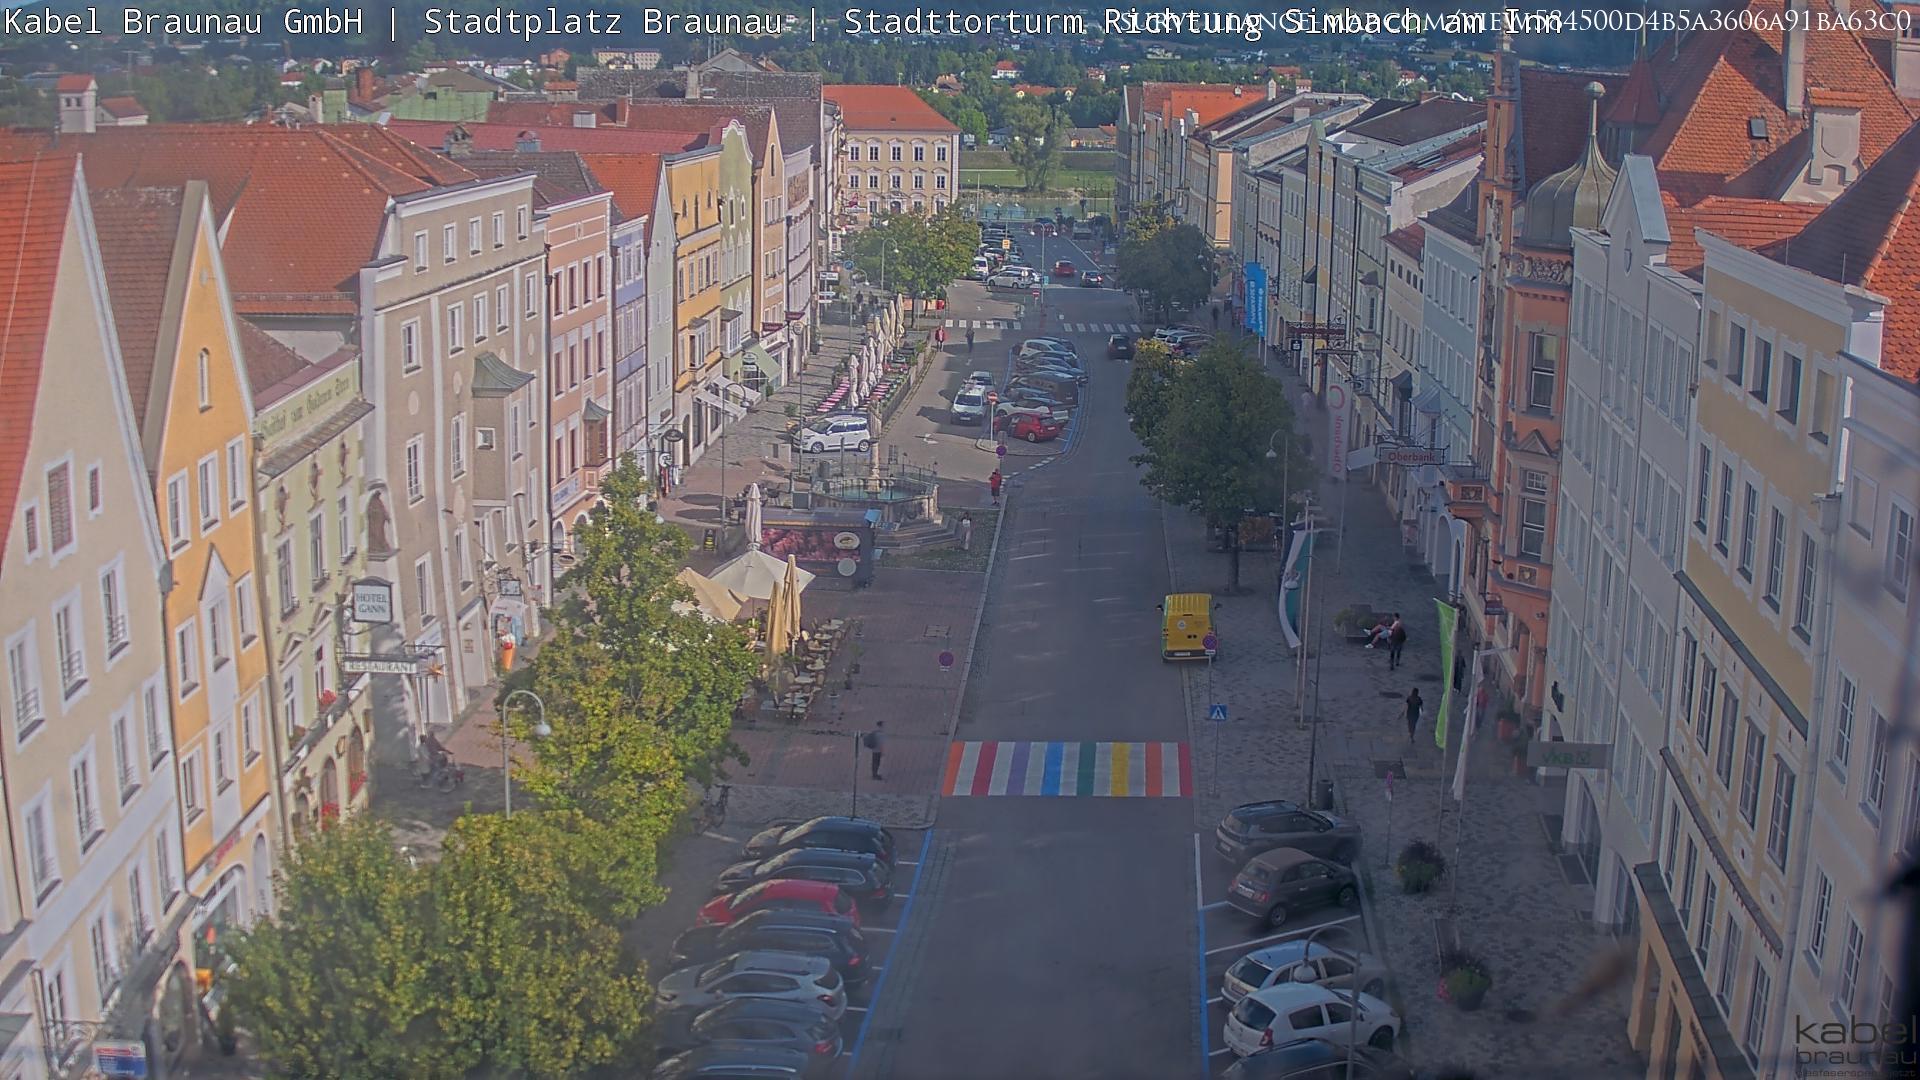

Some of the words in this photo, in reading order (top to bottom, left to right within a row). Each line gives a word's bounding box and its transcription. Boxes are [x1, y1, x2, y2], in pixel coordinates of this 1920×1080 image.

[1388, 451, 1436, 463] Oberbank
[356, 593, 387, 603] HOTEL
[359, 603, 387, 614] GANN
[348, 661, 415, 673] RESTAURANT
